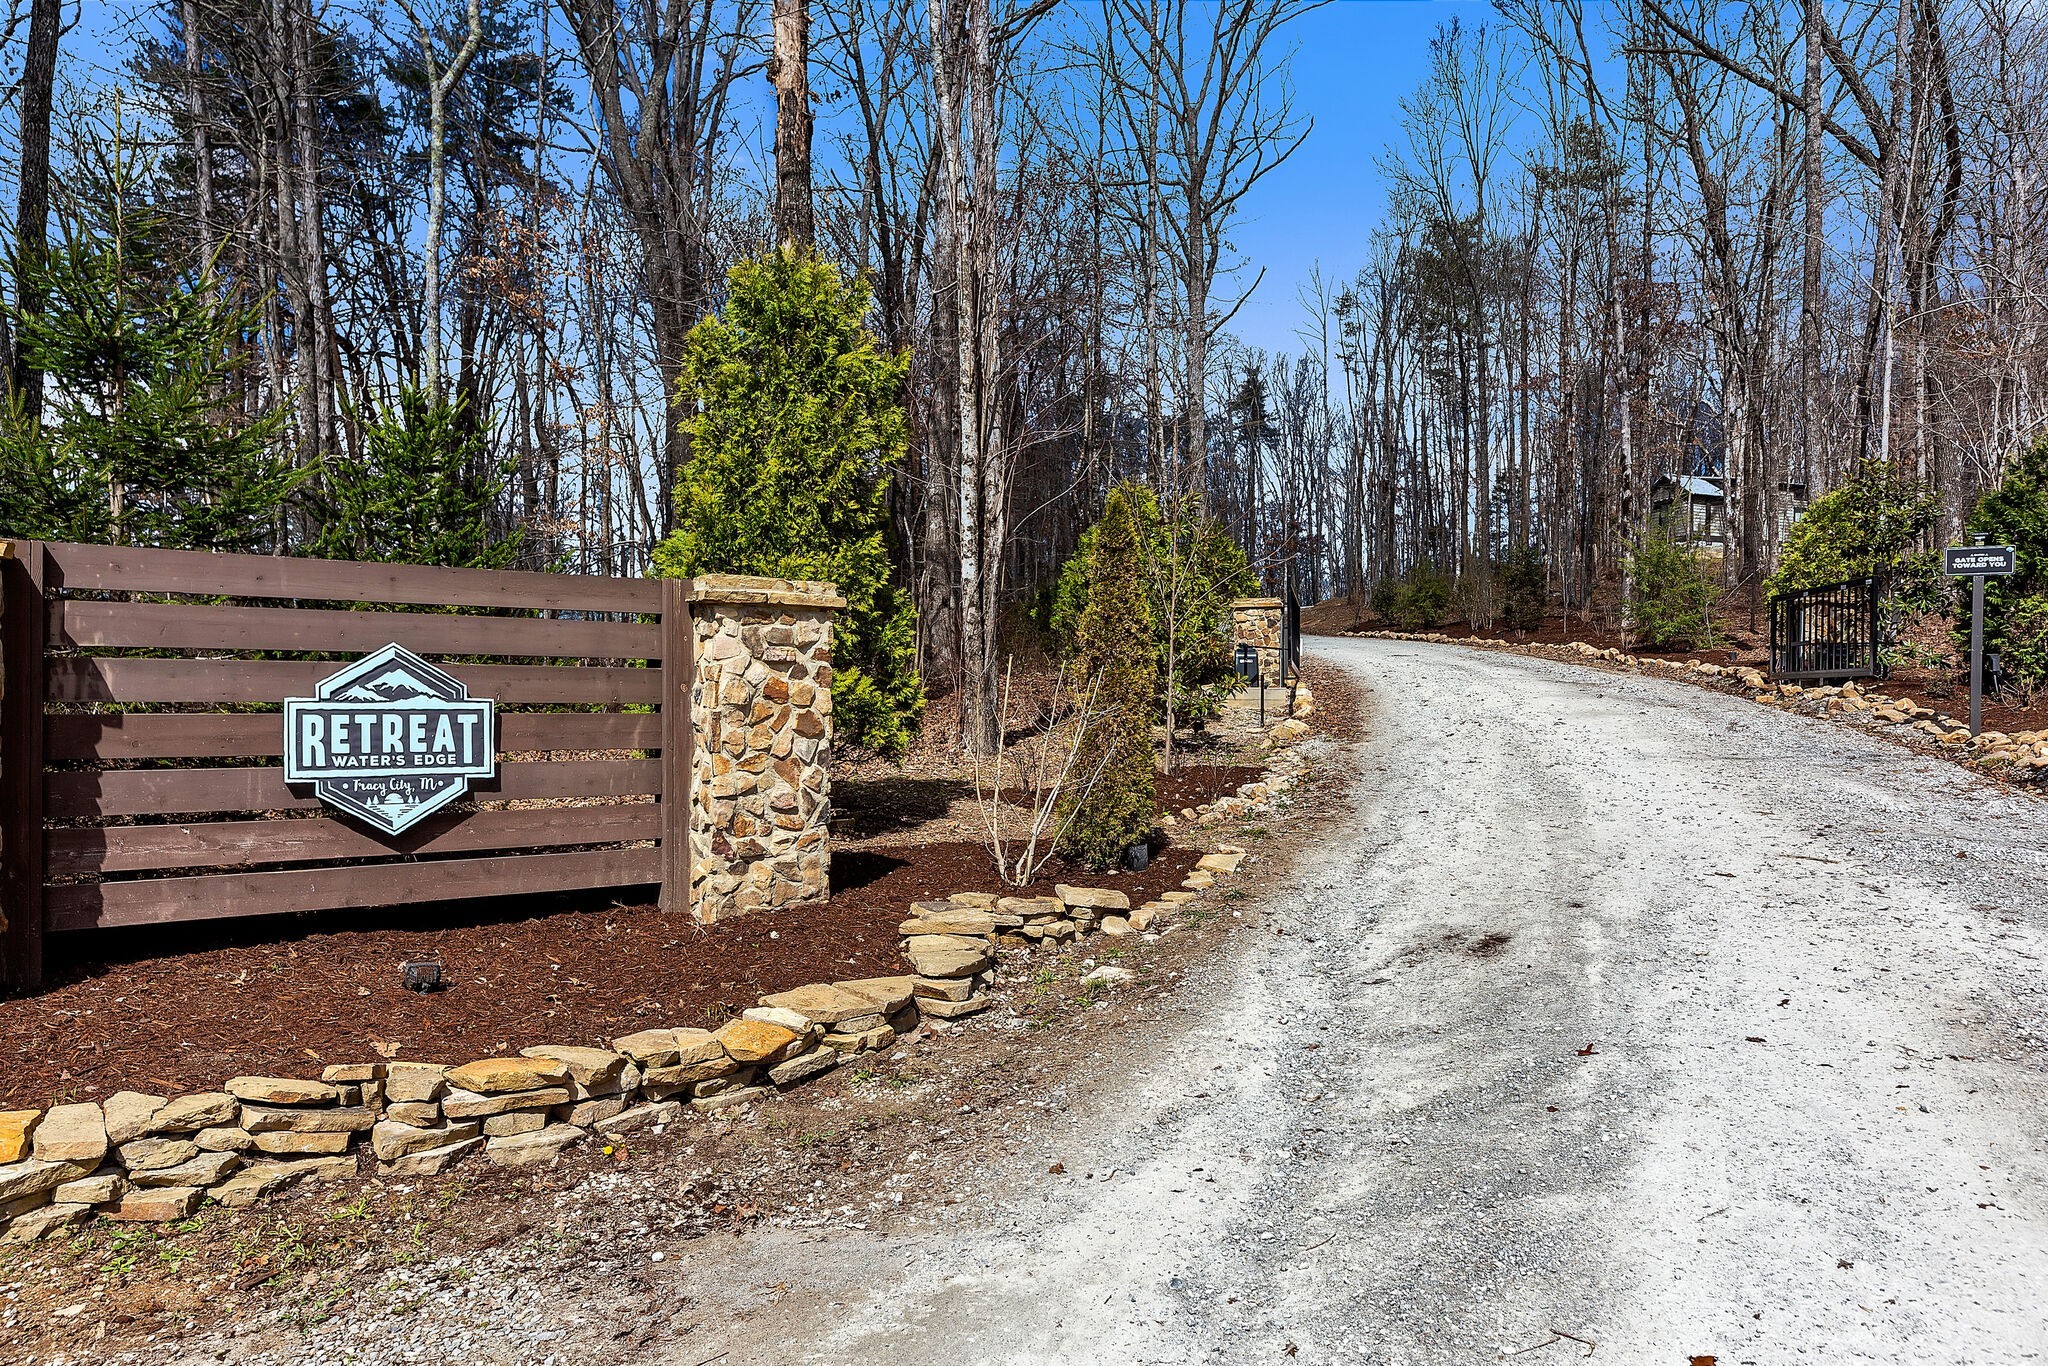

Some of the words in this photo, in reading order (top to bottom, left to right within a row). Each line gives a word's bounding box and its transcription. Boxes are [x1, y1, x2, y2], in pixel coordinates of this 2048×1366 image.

[302, 713, 479, 767] RETREAT
[331, 755, 406, 767] WATER'S
[414, 753, 457, 766] EDGE
[353, 778, 387, 796] Tracy
[389, 777, 415, 796] City,
